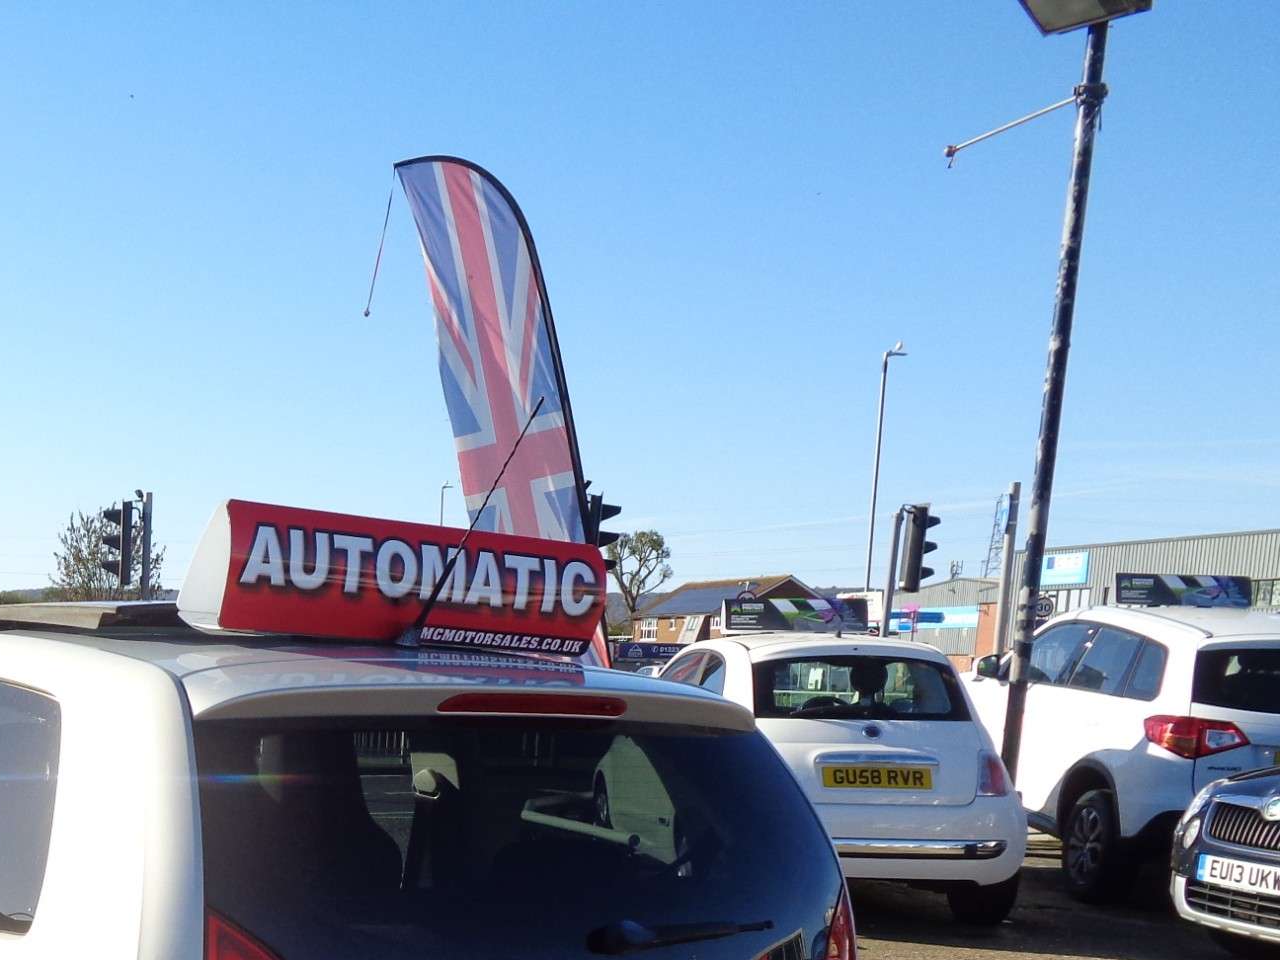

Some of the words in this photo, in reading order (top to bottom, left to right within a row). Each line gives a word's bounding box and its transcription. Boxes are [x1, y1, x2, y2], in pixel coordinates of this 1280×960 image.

[238, 523, 598, 618] AUTOMATIC
[1036, 602, 1050, 612] 30
[420, 626, 584, 653] MCMOTORSALES.CO.UK
[833, 769, 882, 785] GU58
[887, 770, 924, 786] RVR
[1209, 859, 1245, 884] EU13
